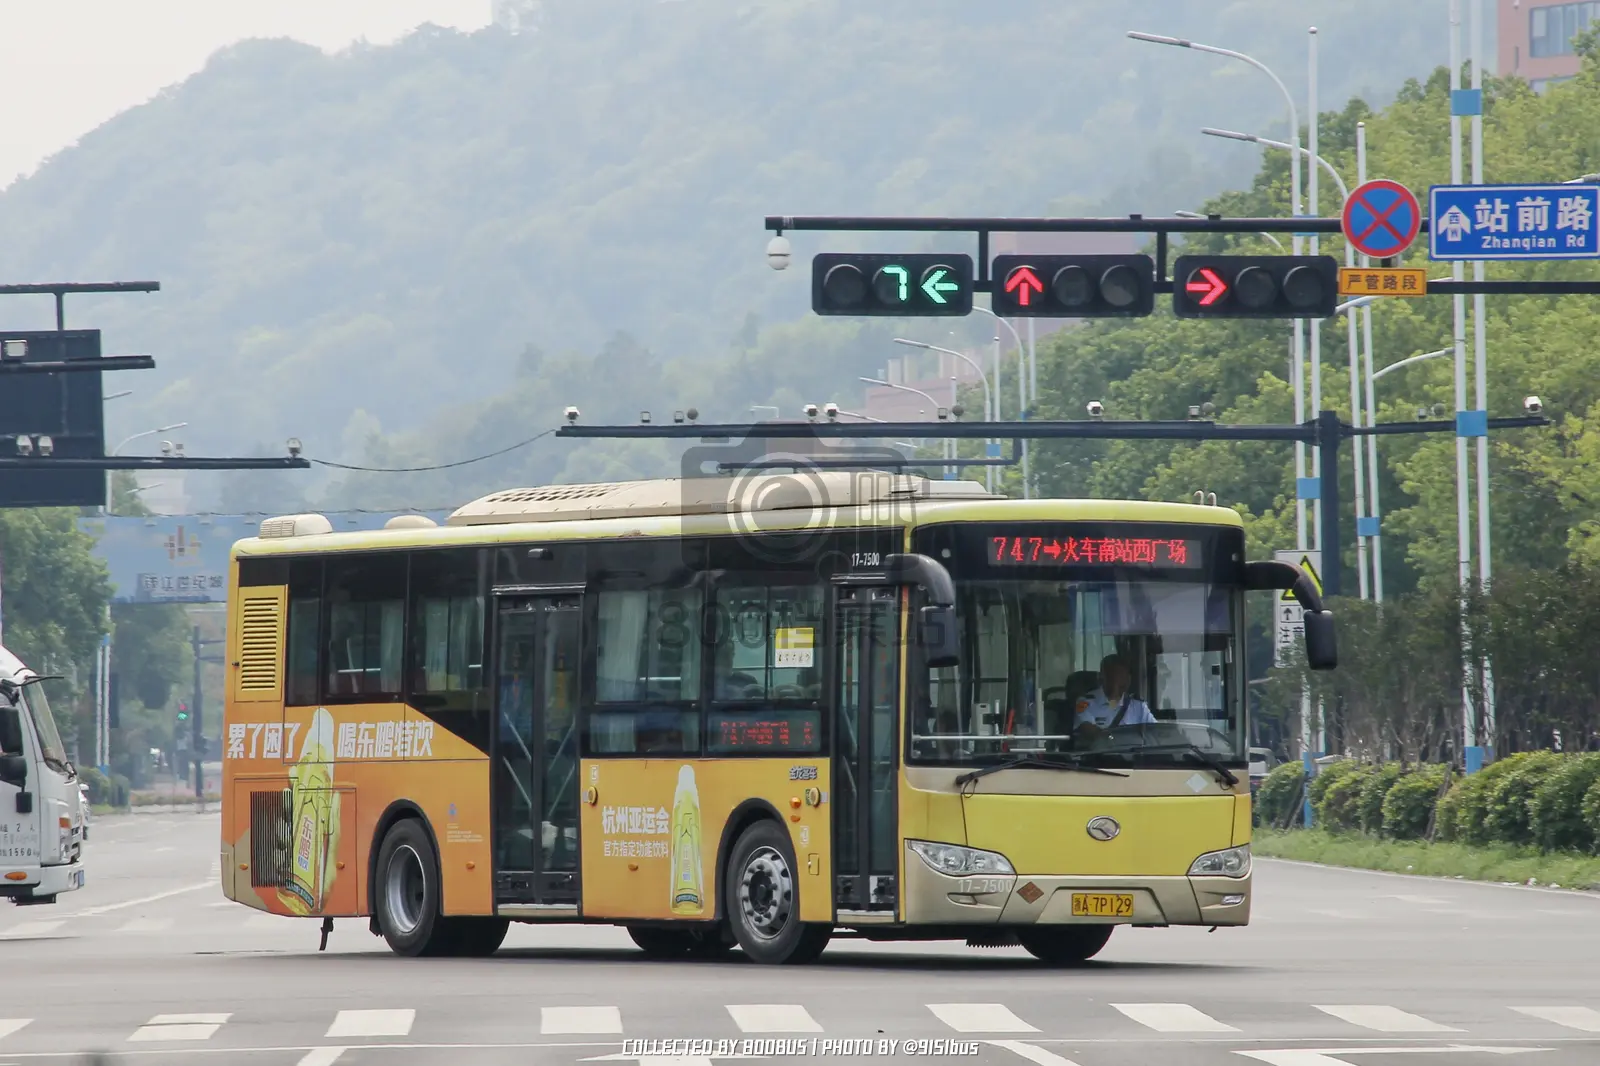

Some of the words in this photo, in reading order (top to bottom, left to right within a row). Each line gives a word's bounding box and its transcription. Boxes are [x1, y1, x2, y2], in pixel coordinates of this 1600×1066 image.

[1474, 196, 1593, 232] 站前路
[1481, 235, 1556, 251] Zhanqian
[1566, 234, 1586, 248] Rd
[882, 266, 908, 301] 7
[1347, 274, 1417, 291] 严管路段
[851, 553, 880, 566] 17-7500
[993, 537, 1042, 561] 747
[1063, 537, 1186, 564] 火车南站西广场
[227, 723, 300, 759] 累了困了
[336, 720, 434, 758] 喝东鹏特饮
[602, 806, 670, 835] 杭州亚运会
[603, 840, 669, 858] 官方指定功能饮料
[957, 879, 1013, 893] 17-7500
